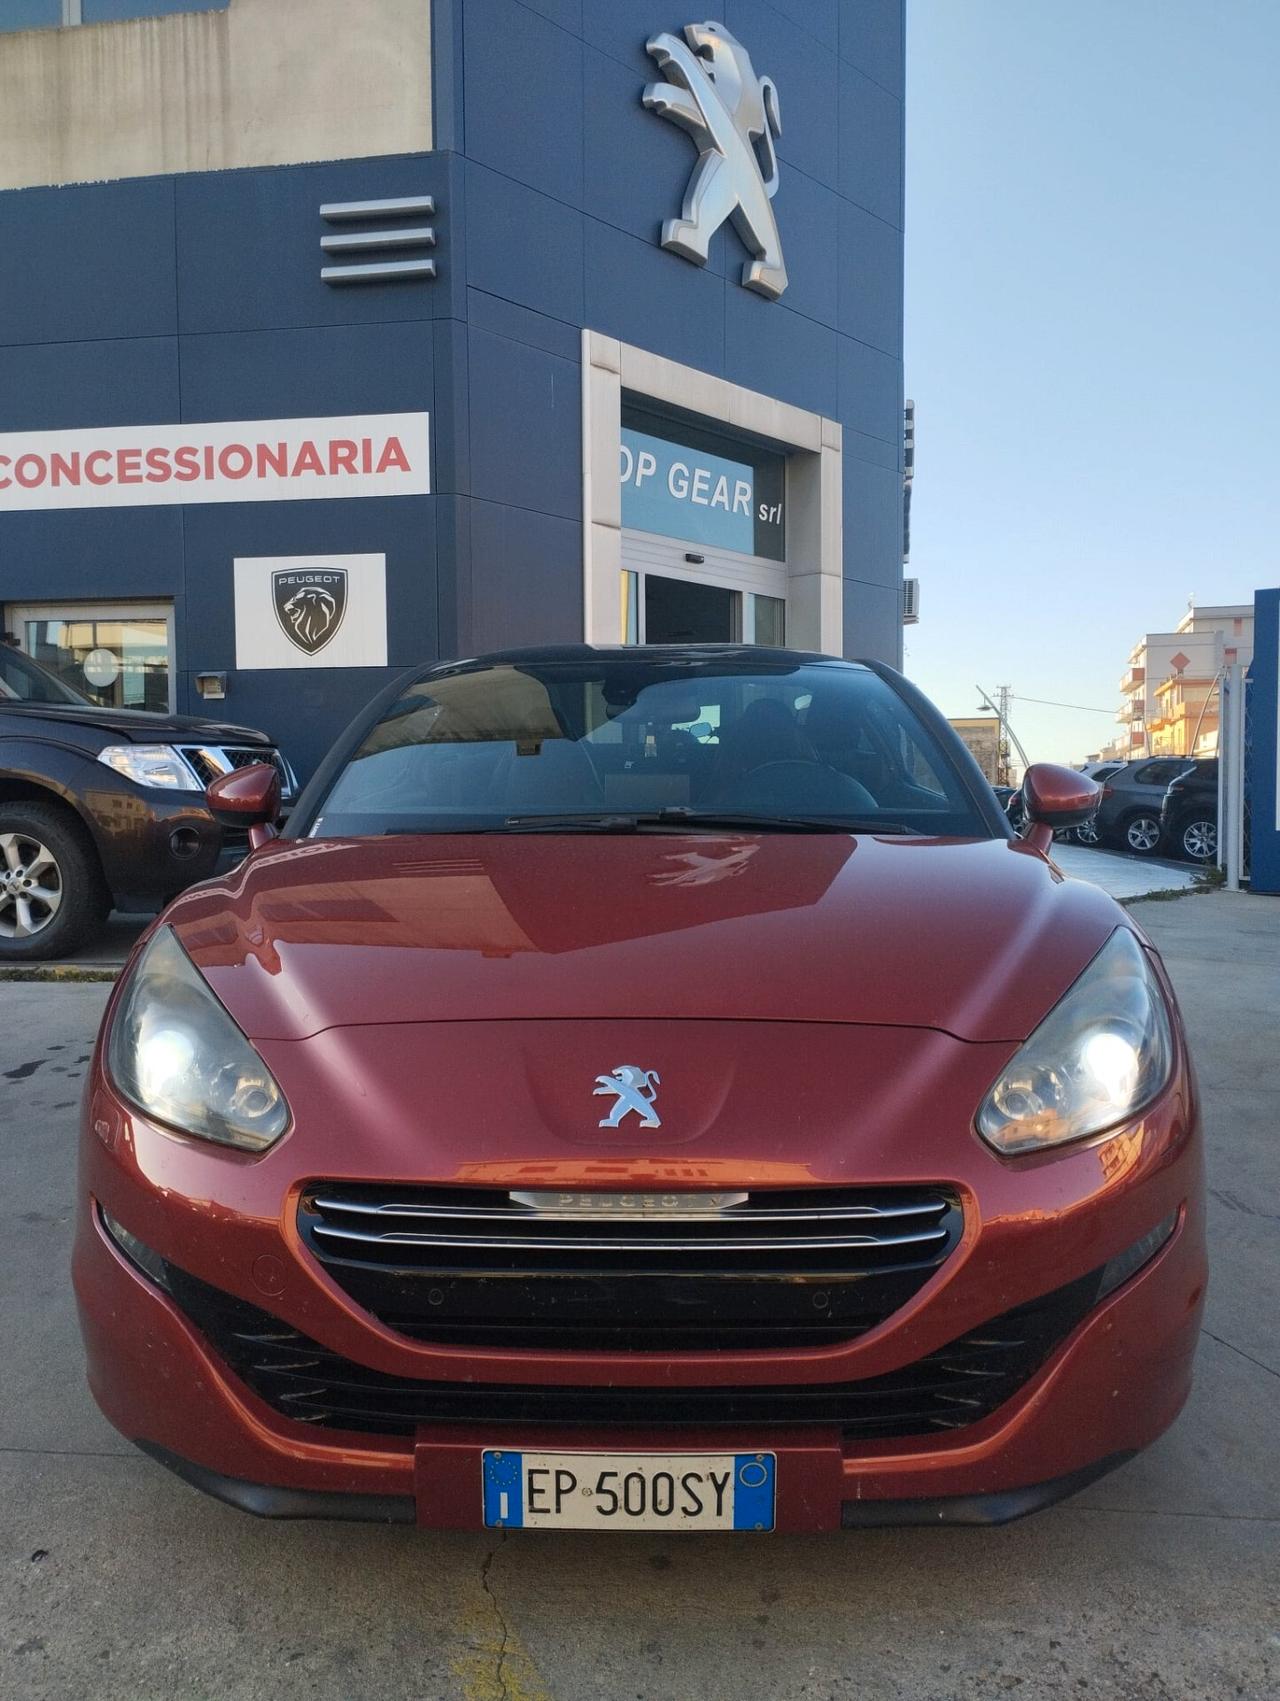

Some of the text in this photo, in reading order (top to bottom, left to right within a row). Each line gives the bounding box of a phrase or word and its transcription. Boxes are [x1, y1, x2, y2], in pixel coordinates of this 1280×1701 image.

[668, 462, 752, 516] GEAR
[758, 503, 782, 525] srl
[279, 575, 340, 585] PEUGEOT
